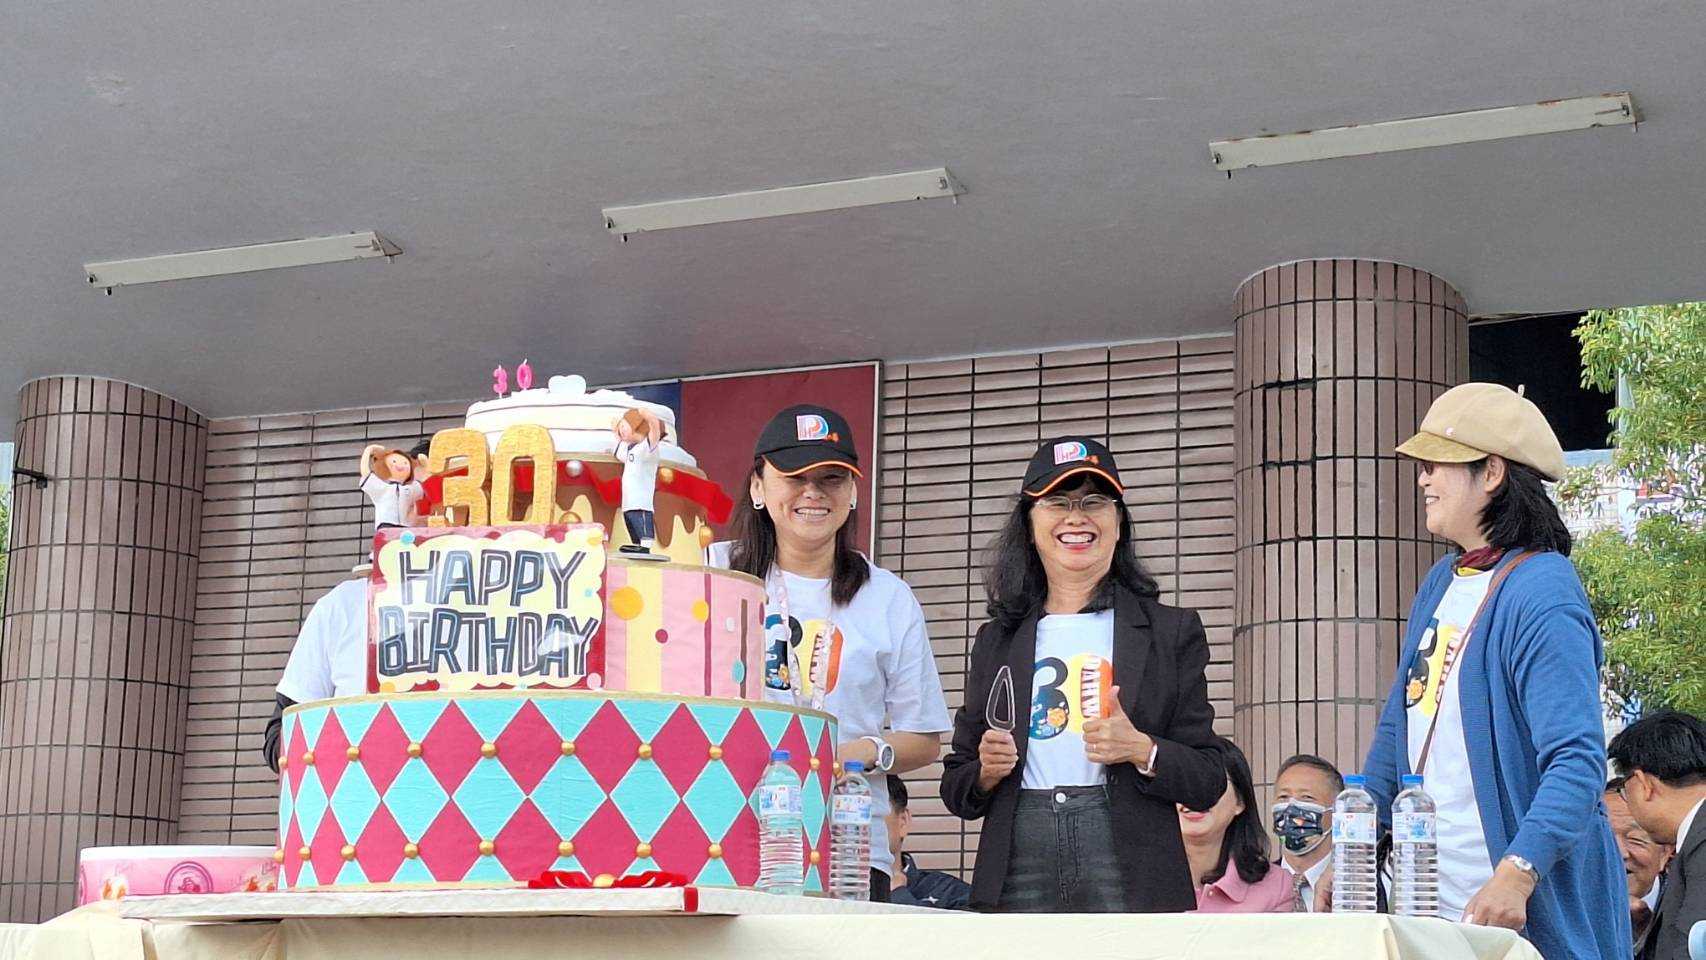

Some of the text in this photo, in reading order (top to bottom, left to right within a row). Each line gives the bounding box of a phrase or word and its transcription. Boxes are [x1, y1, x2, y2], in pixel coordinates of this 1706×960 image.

[493, 364, 532, 394] 30
[428, 424, 556, 528] 30
[399, 550, 588, 610] HAPPY
[378, 605, 599, 679] BIRTHDAY
